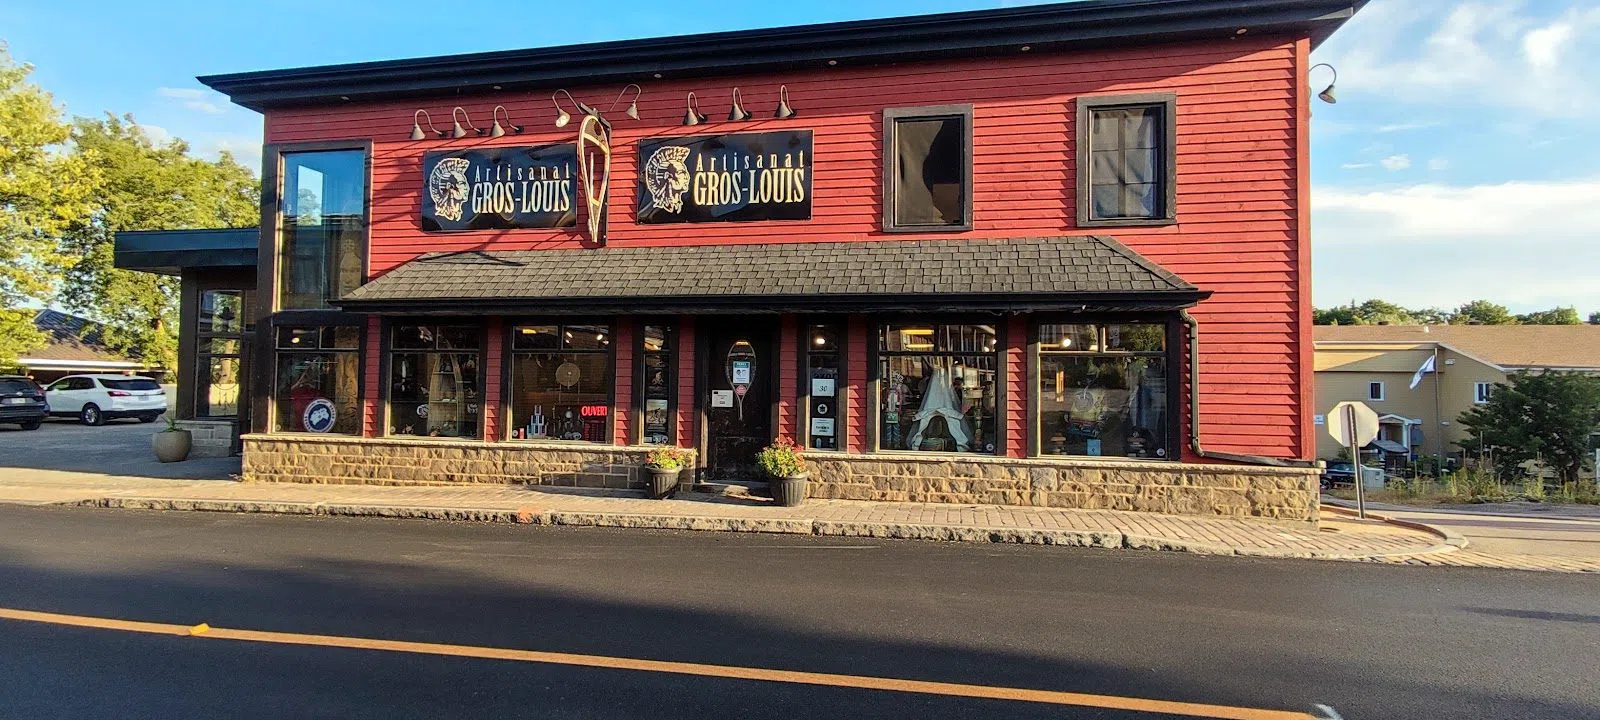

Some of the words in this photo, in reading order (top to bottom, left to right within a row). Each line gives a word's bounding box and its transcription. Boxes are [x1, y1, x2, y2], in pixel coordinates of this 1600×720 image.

[696, 150, 805, 171] Artisanat
[475, 162, 570, 182] Artisanat
[472, 180, 570, 214] GROS-LOUIS
[694, 168, 805, 206] GROS-LOUIS
[581, 405, 608, 417] OUVERT
